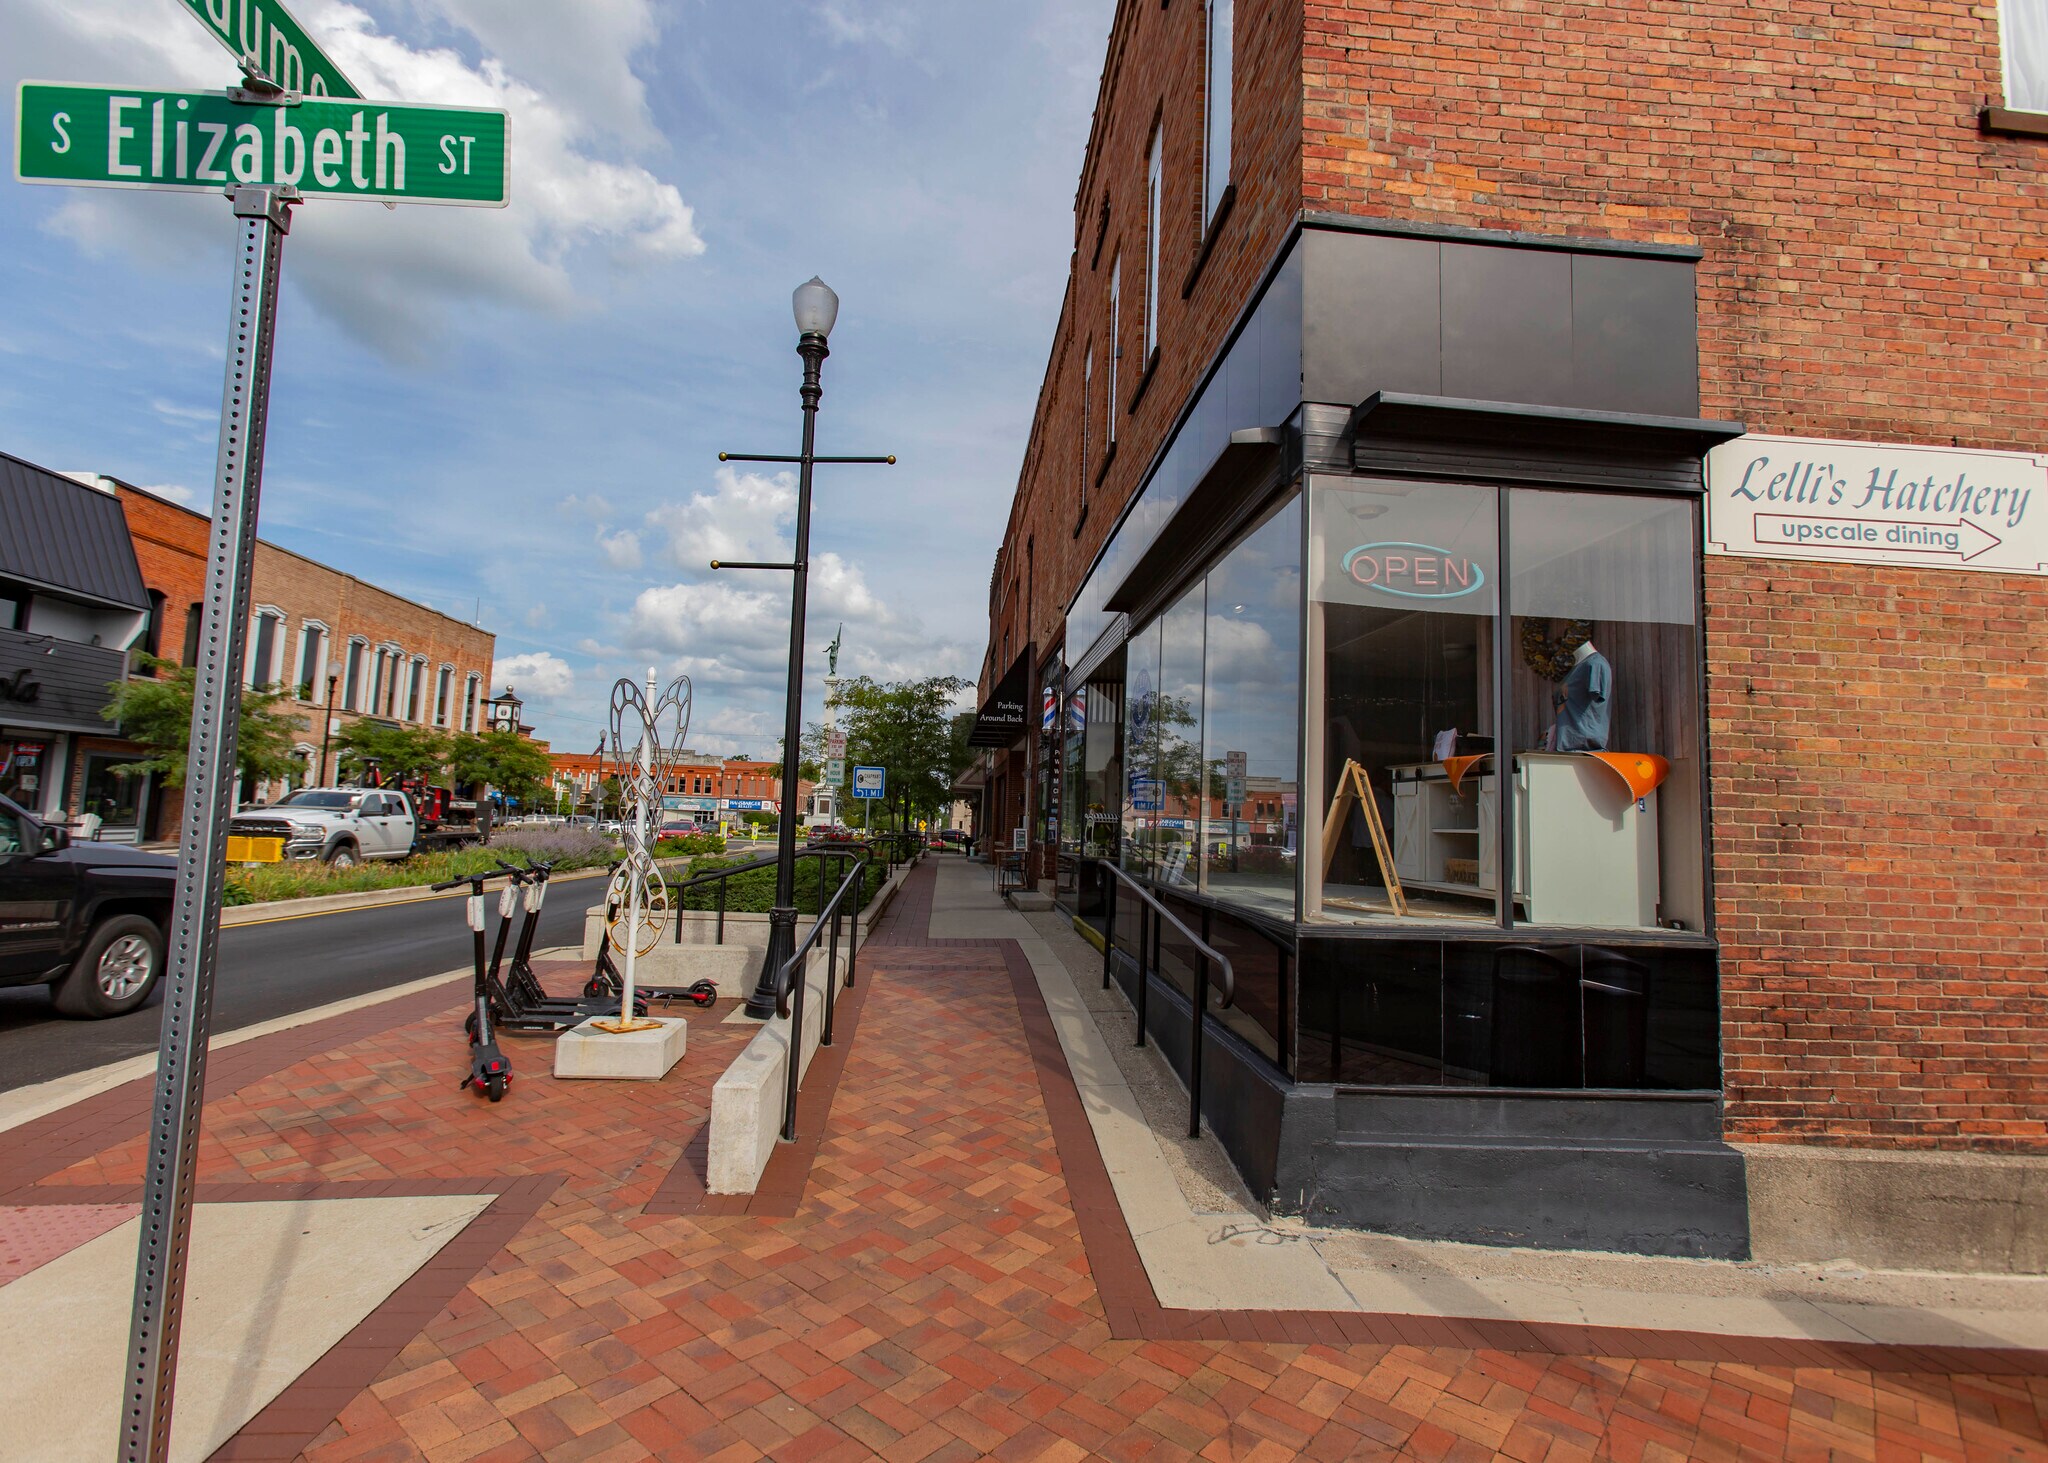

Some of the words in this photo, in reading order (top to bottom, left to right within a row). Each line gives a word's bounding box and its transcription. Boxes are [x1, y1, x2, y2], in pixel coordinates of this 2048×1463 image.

[51, 112, 72, 154] S
[107, 95, 407, 191] Elizabeth
[437, 134, 477, 176] ST
[1730, 455, 1847, 506] Lelli's
[1852, 466, 2032, 528] Hatchery
[1781, 521, 1878, 542] upscale
[1885, 524, 1960, 550] dining
[1351, 555, 1469, 586] OPEN
[980, 713, 1006, 722] Around
[1007, 713, 1023, 723] Back
[997, 701, 1024, 712] Parking
[870, 789, 880, 797] MI
